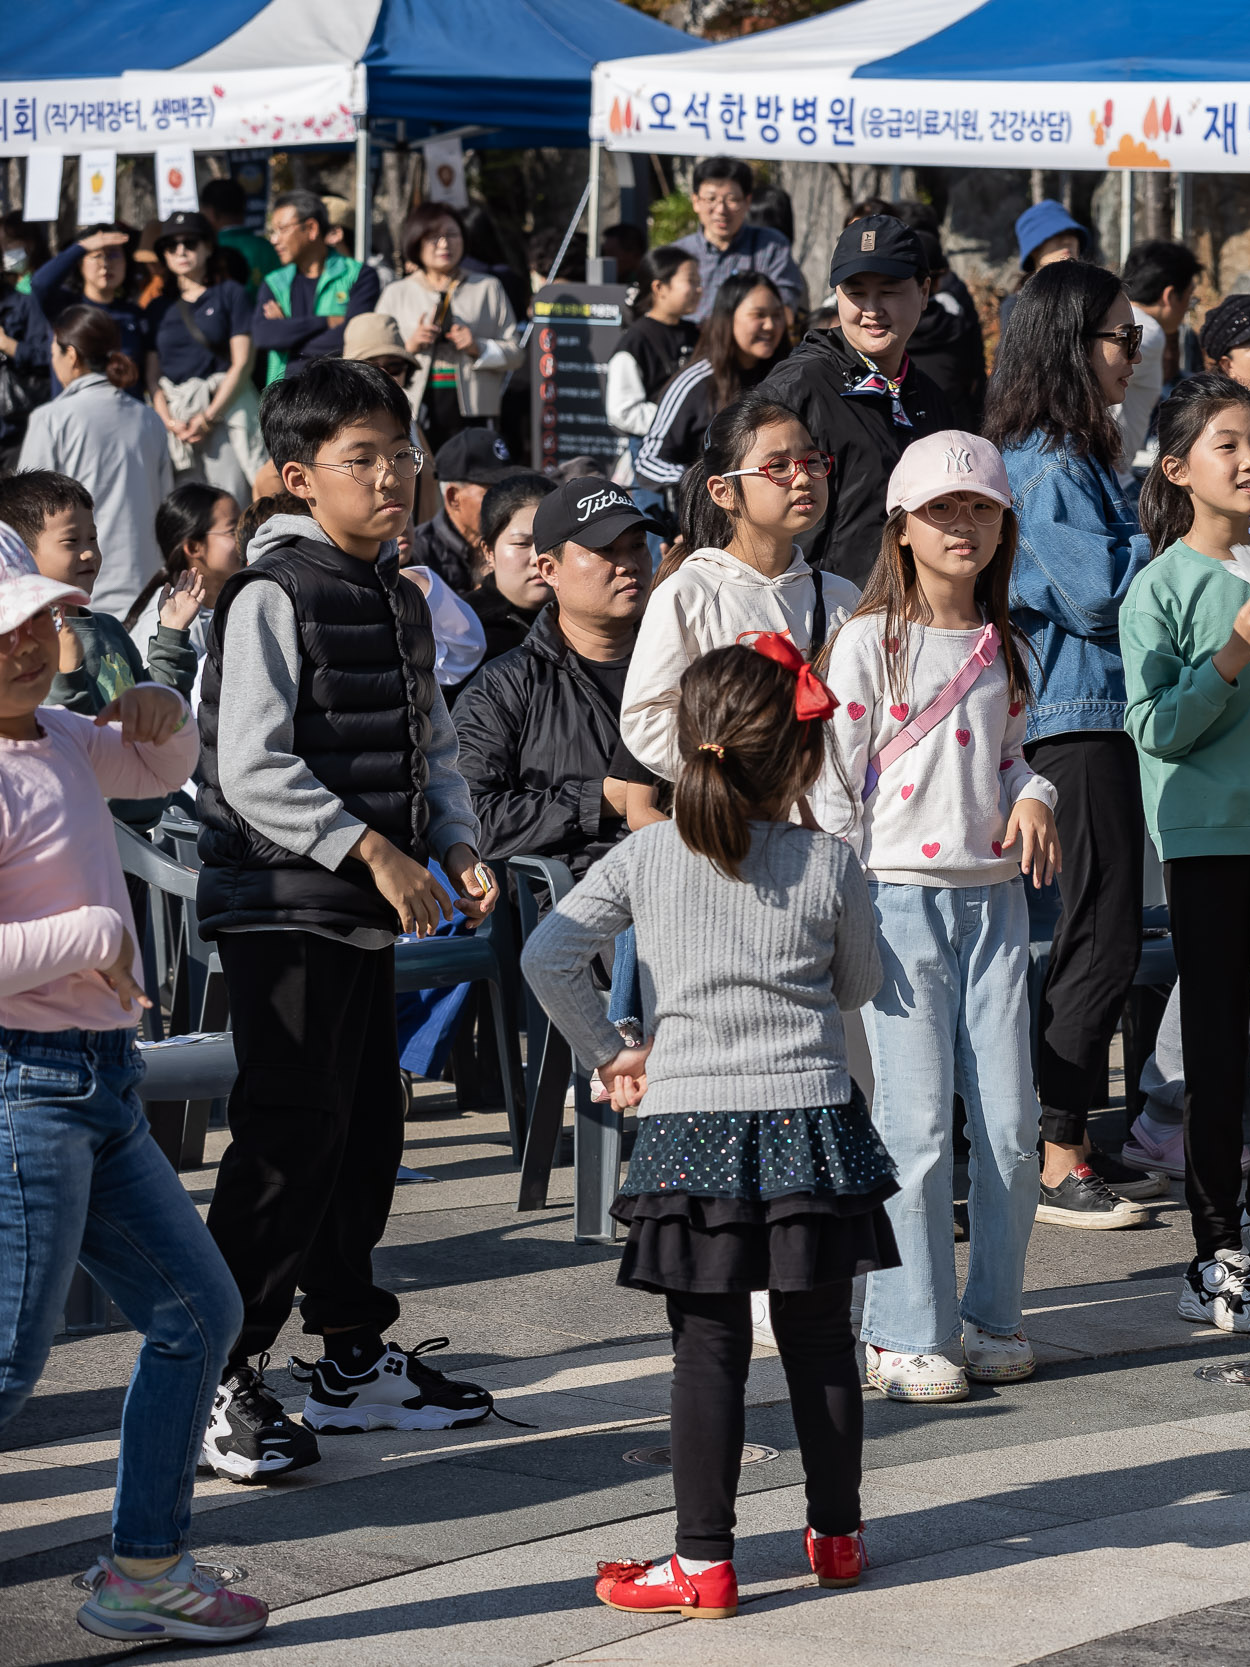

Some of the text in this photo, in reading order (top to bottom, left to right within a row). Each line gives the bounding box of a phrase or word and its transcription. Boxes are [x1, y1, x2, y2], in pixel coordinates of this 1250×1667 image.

[45, 100, 148, 133] (직거래장터,
[153, 95, 216, 130] 생맥주)
[648, 92, 1072, 146] 오석한방병원 (응급의료지원, 건강상담)
[944, 447, 973, 474] NY
